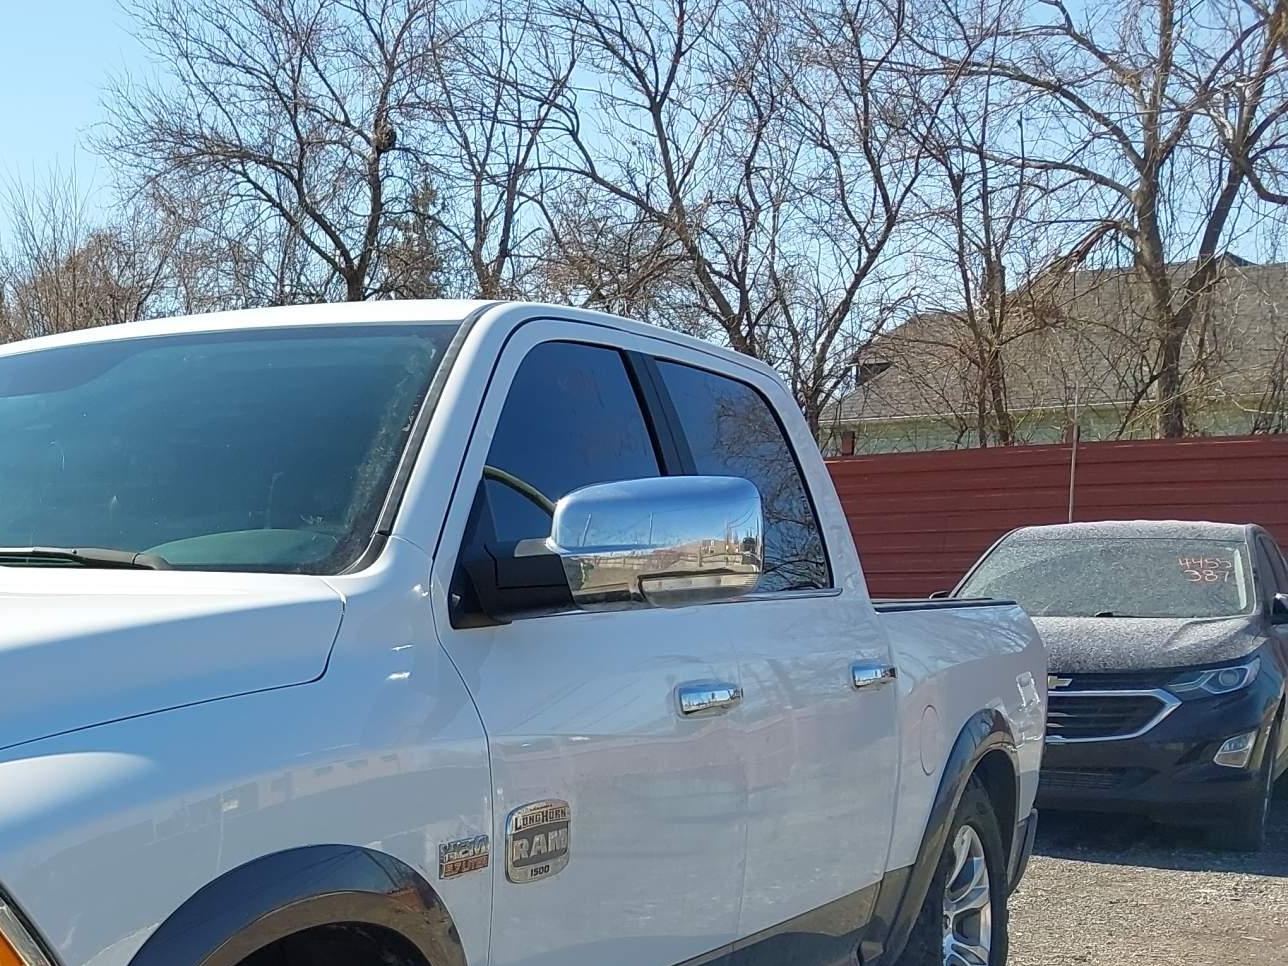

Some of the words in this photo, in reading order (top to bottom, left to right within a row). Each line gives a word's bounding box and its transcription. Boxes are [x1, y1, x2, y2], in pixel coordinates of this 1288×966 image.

[1183, 569, 1230, 583] 387
[512, 828, 568, 861] RAM
[530, 864, 550, 877] 1500
